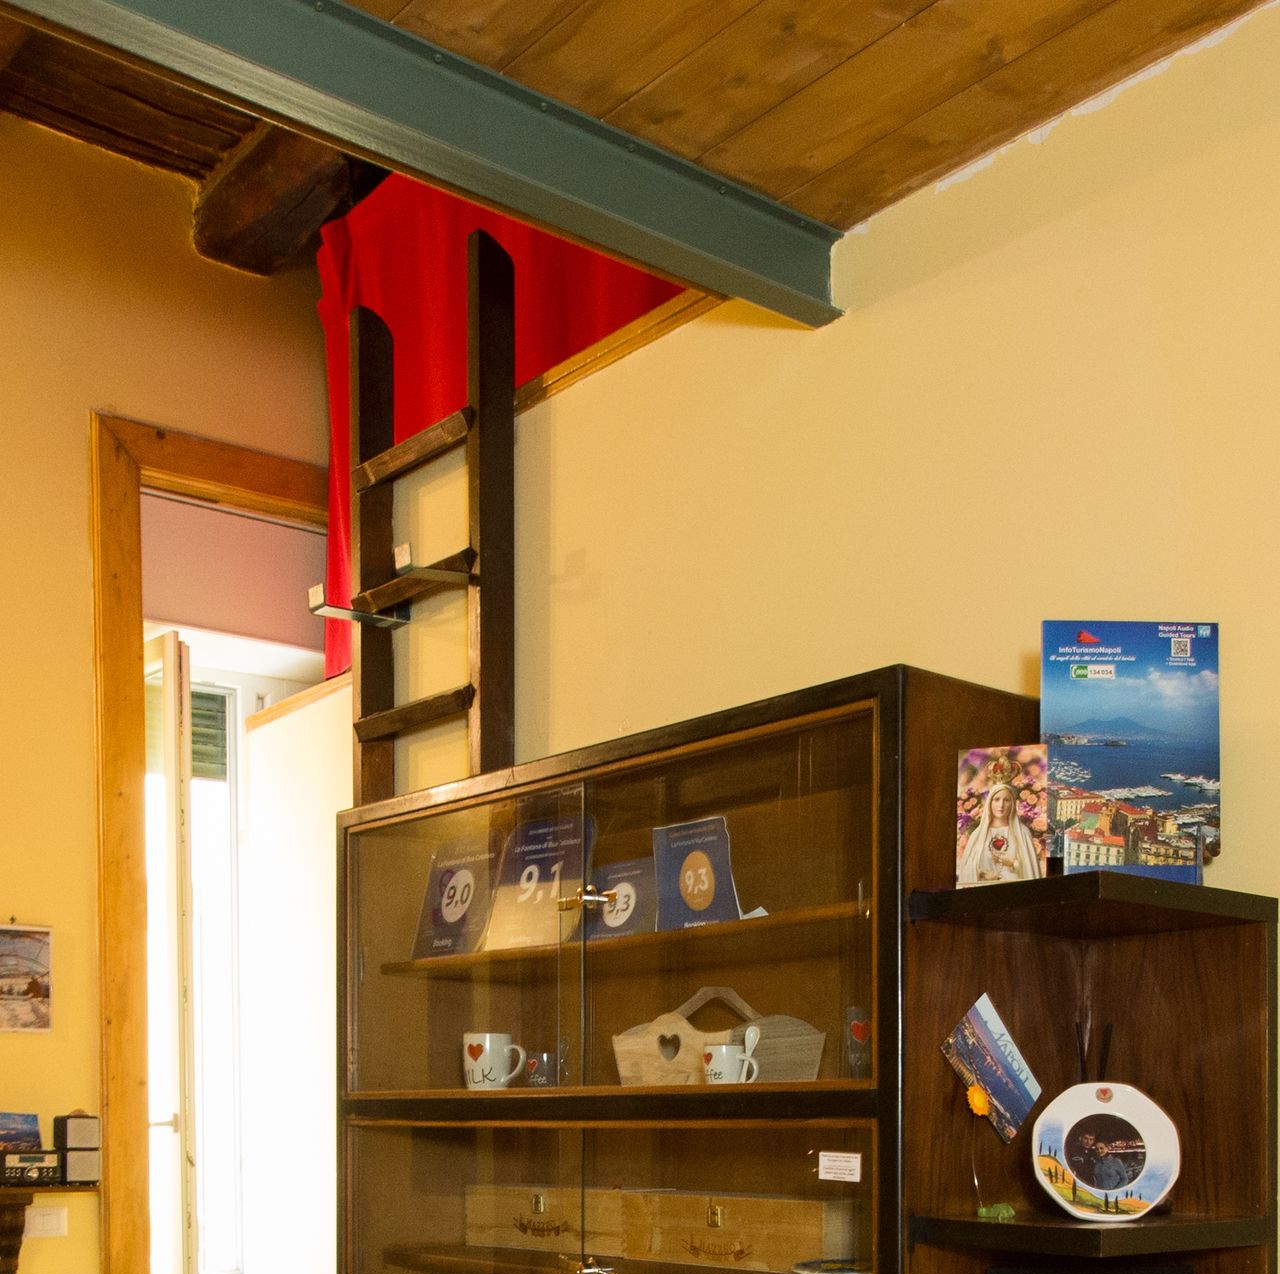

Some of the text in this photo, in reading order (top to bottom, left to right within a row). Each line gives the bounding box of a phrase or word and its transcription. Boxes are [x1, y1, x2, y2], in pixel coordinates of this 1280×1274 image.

[1058, 646, 1122, 654] InfoTurismoNapoli
[516, 860, 565, 904] 9,1
[684, 867, 709, 894] 9,3
[445, 882, 471, 908] 9,0
